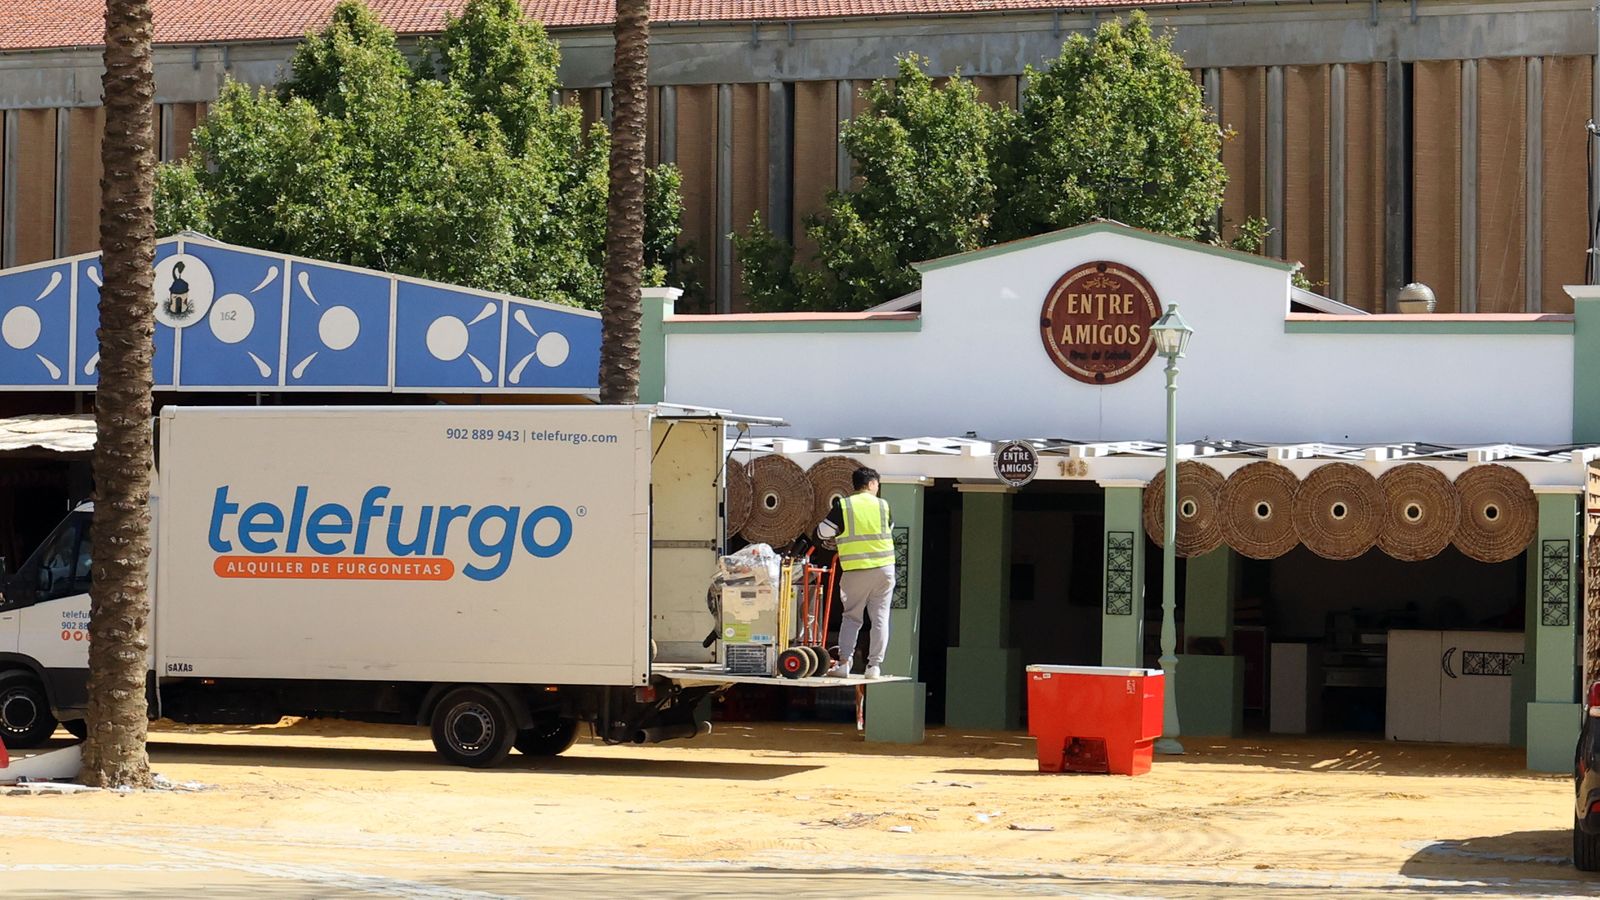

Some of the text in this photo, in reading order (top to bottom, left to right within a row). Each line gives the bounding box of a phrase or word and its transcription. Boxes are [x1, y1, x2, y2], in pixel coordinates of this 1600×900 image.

[1067, 293, 1134, 321] ENTRE
[220, 310, 237, 321] 162
[1061, 324, 1141, 345] AMIGOS
[446, 428, 618, 445] 902 889 943 telefurgo.com
[1003, 451, 1030, 463] ENTRE
[1000, 463, 1033, 473] AMIGOS
[208, 485, 573, 581] telefurgo
[226, 561, 442, 576] ALQUILER DE FURGONETAS
[61, 621, 89, 630] 902 88
